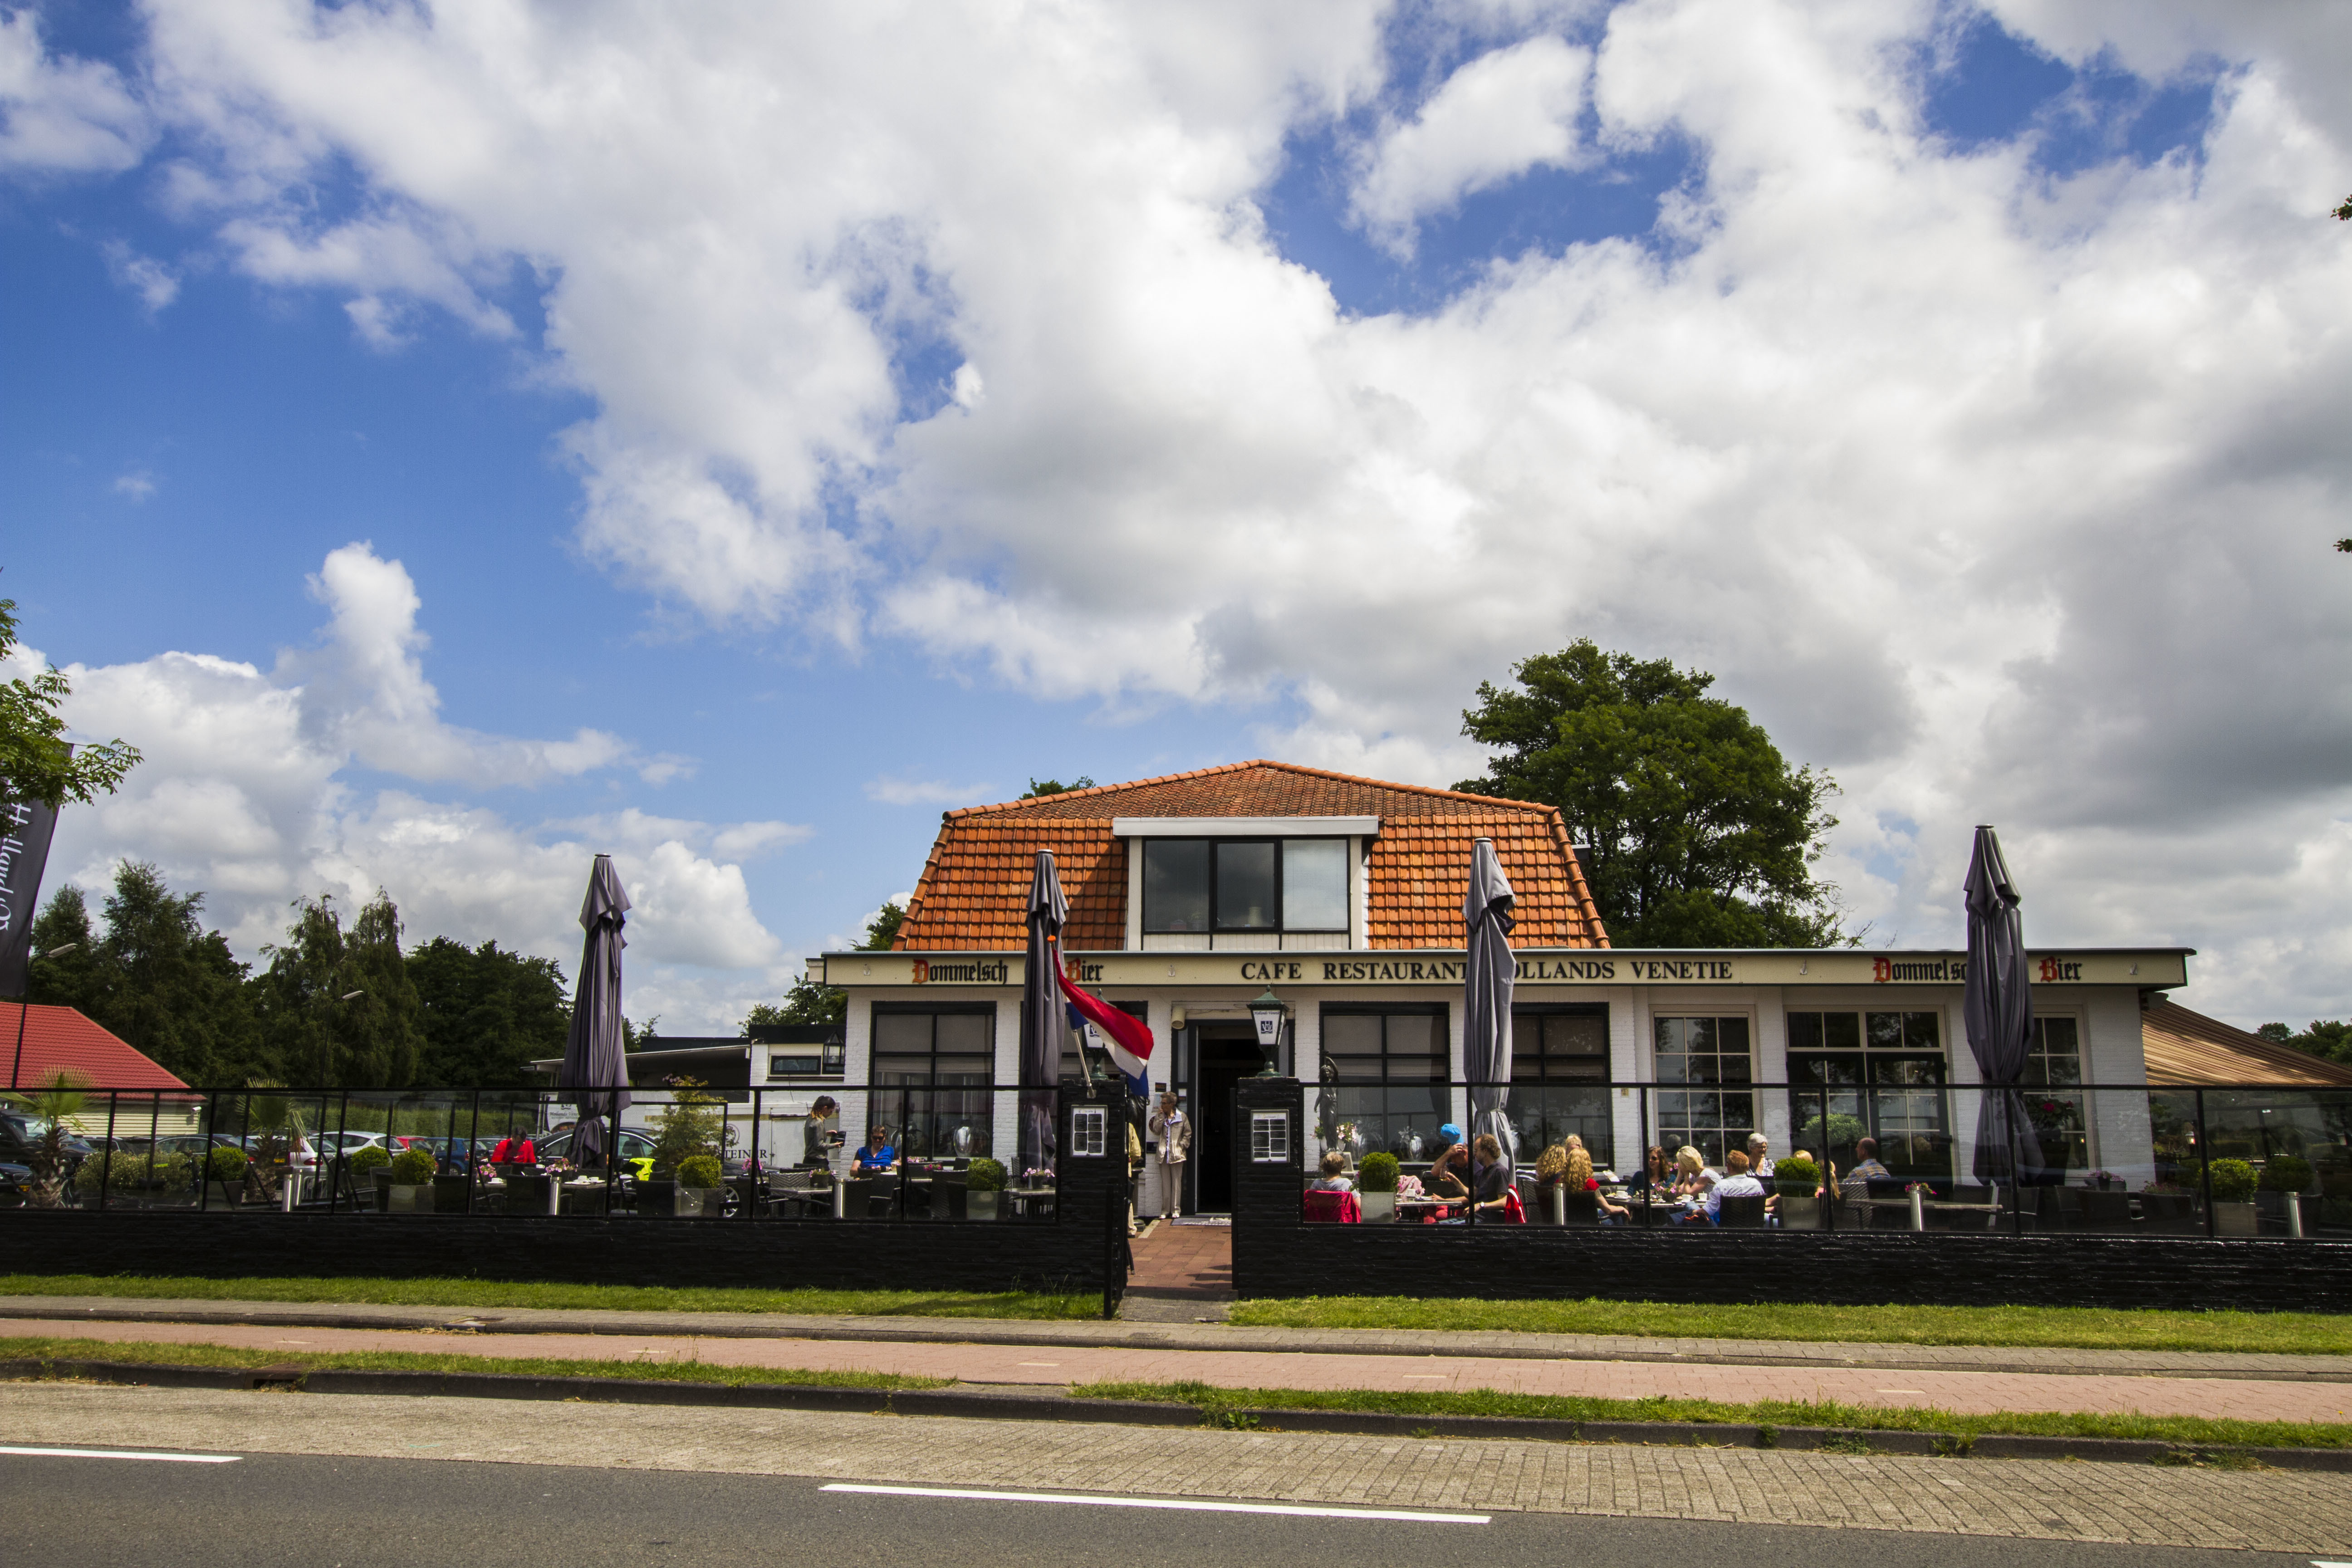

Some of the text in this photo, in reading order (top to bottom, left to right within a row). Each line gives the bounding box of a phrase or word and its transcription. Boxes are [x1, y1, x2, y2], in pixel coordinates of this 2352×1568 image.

[912, 958, 1103, 984] Dommelsch Bier
[1241, 961, 1733, 980] CAFE RESTAURANT LLANDS VENETIE
[1873, 956, 2083, 982] Dommelsc Bier
